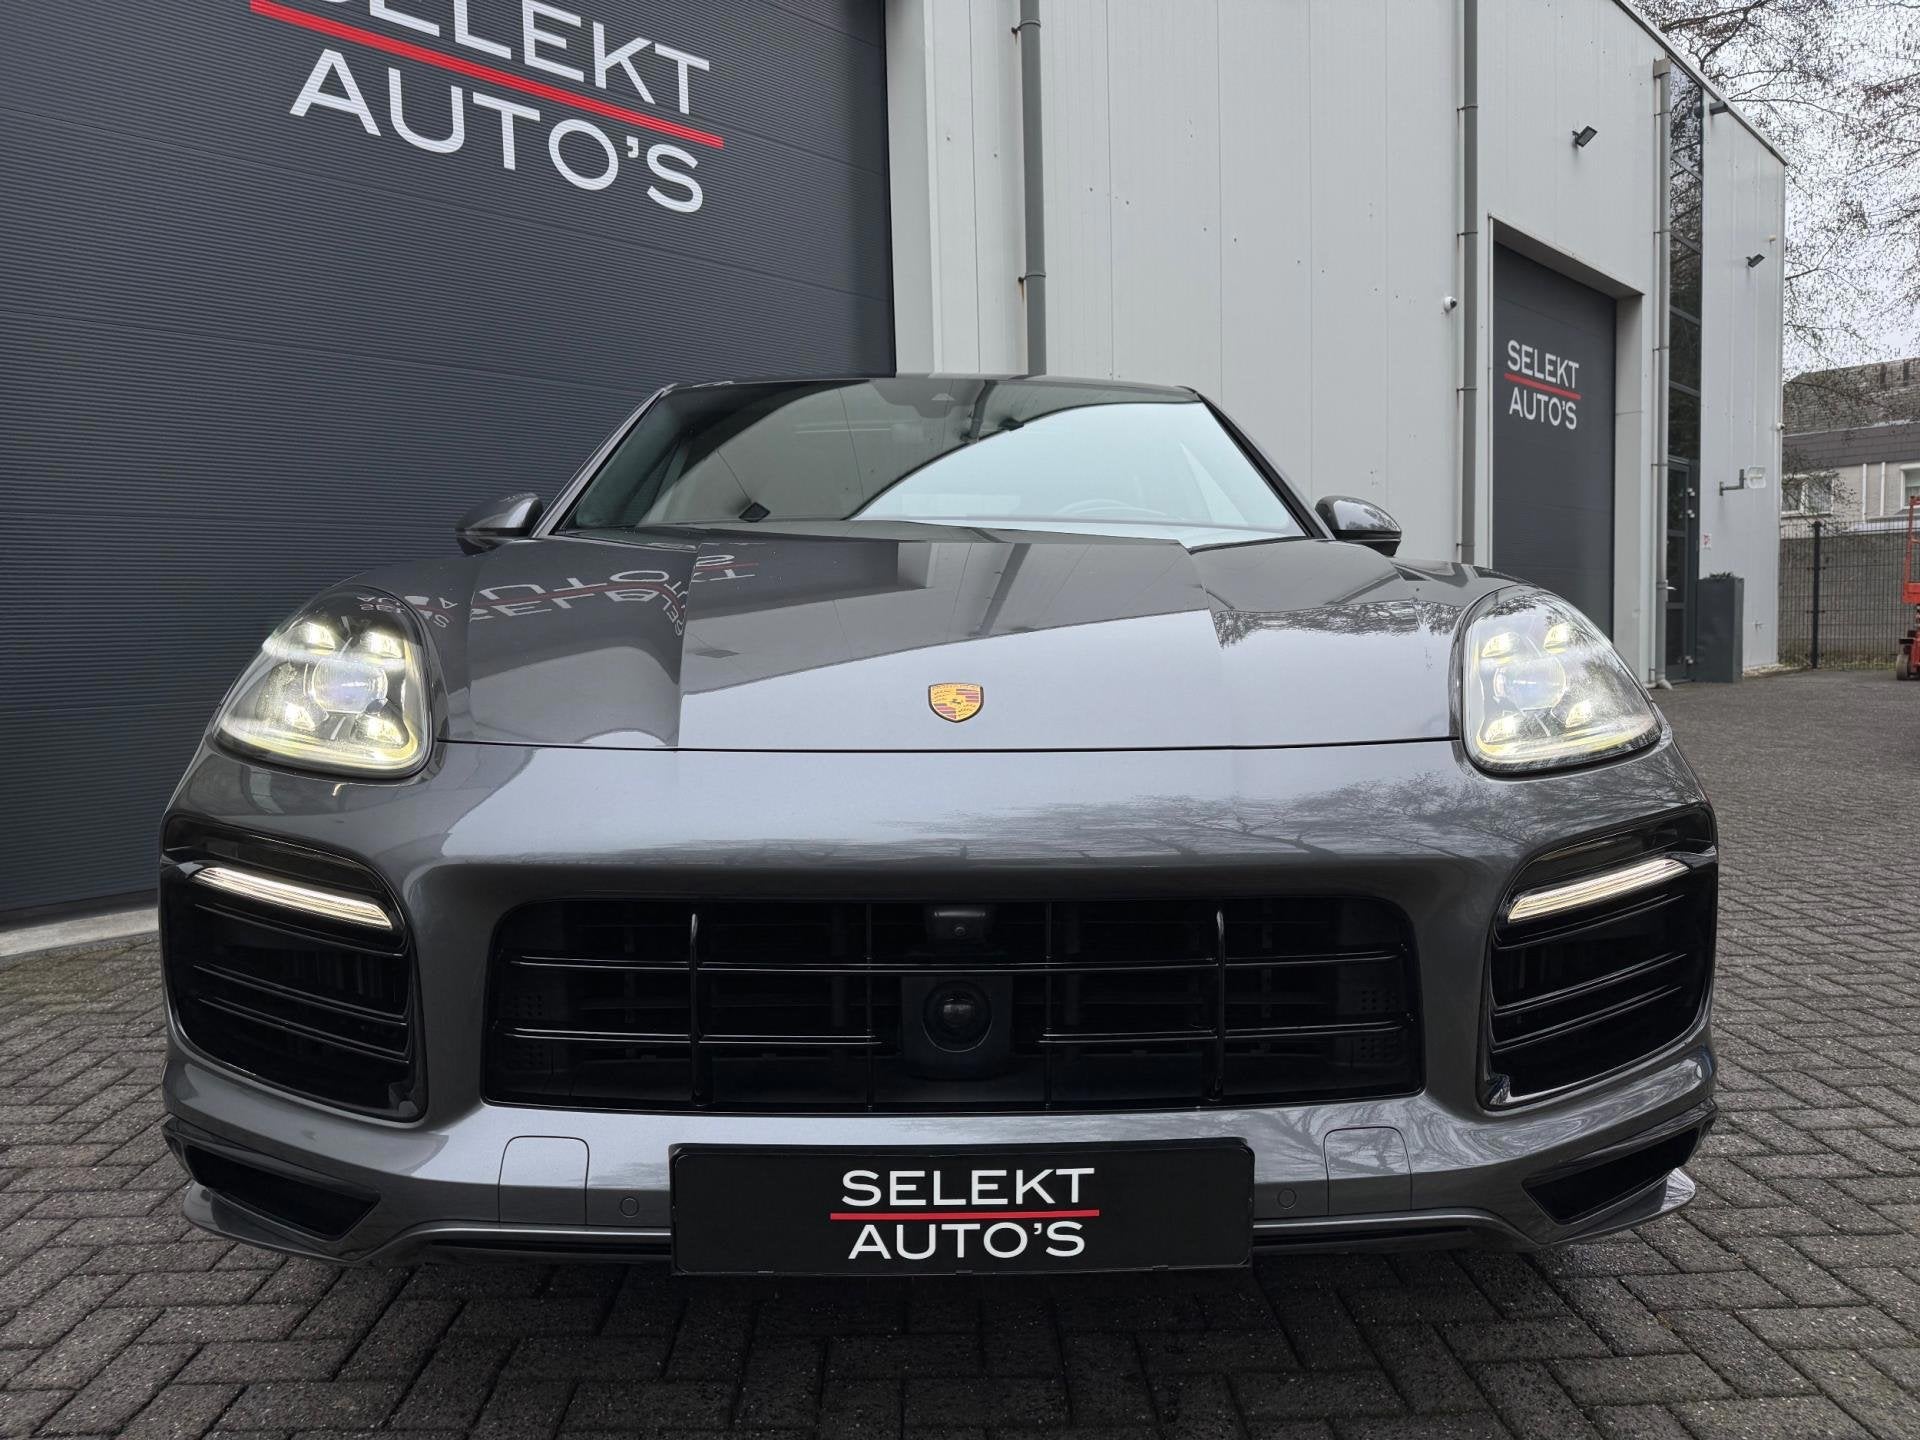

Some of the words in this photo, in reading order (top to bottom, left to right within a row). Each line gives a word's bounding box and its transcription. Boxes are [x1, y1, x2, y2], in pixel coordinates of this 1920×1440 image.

[322, 0, 710, 115] LEKT
[289, 48, 704, 213] AUTO'S
[1507, 339, 1580, 389] SELEKT
[1508, 386, 1578, 430] AUTO'S
[841, 1167, 1095, 1207] SELEKT
[848, 1221, 1086, 1260] AUTO'S
